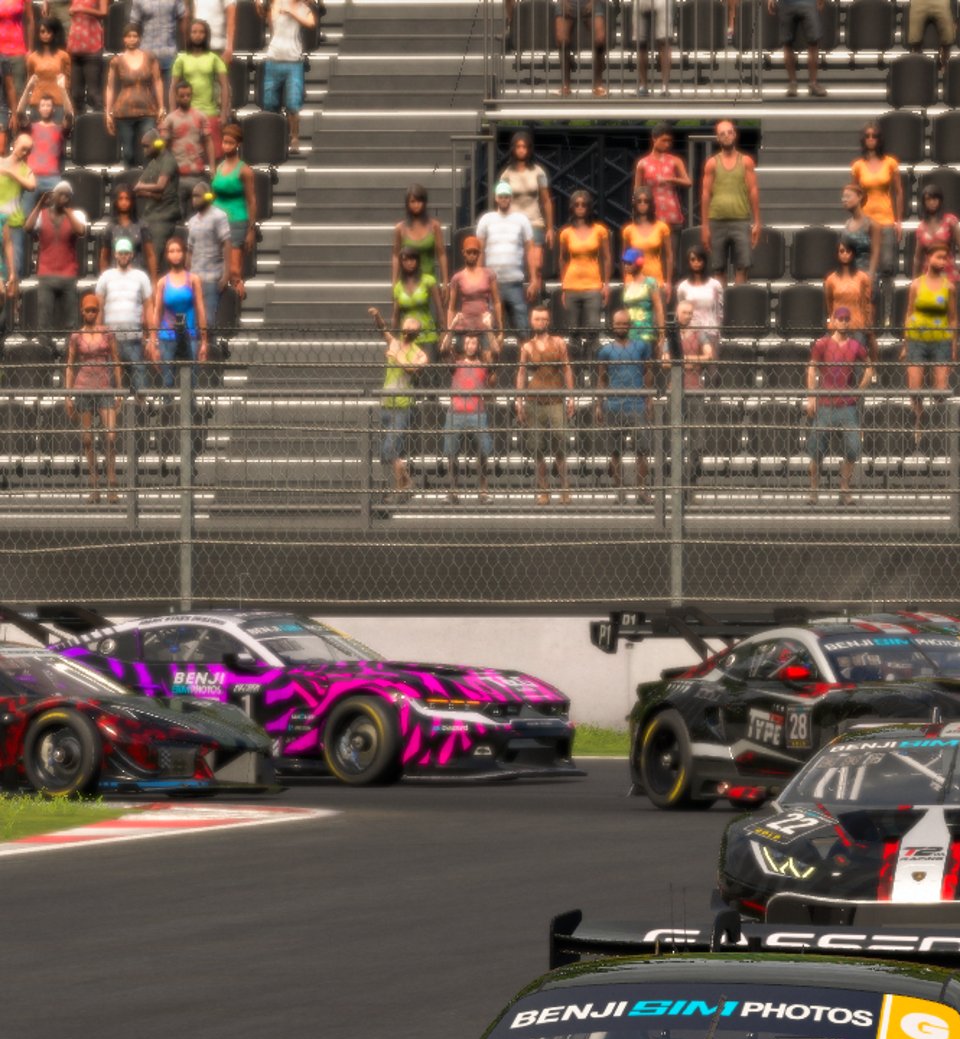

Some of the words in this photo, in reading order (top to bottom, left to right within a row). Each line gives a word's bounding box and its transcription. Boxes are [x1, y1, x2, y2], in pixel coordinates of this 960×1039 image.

[622, 614, 636, 625] D1
[600, 624, 612, 646] P1
[824, 640, 874, 651] BENJI
[172, 671, 225, 685] BENJI
[789, 713, 808, 740] 28
[829, 741, 898, 752] BENJI
[765, 812, 820, 836] 22
[510, 1001, 629, 1030] BENJI
[627, 1000, 740, 1018] SIM
[740, 1001, 874, 1028] PHOTOS
